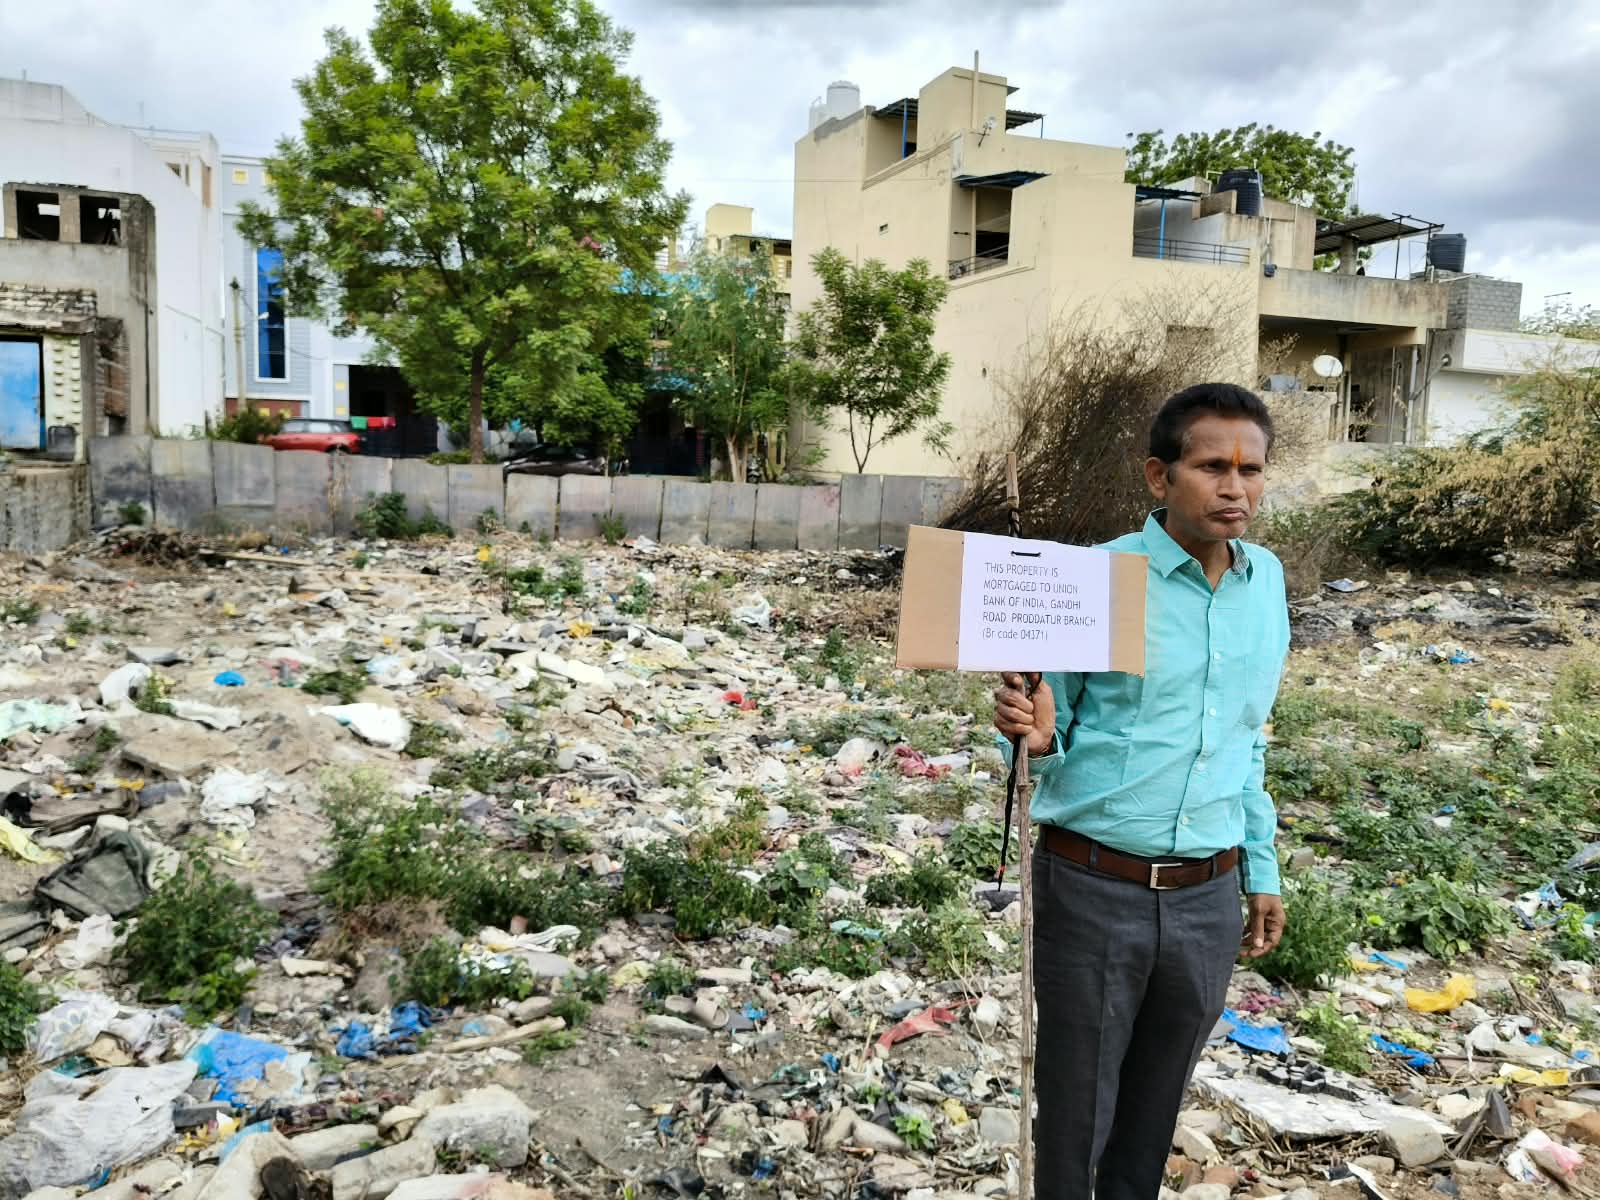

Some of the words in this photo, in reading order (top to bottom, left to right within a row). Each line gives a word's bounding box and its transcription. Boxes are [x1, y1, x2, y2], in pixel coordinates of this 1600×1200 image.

[985, 562, 1004, 574] THIS
[1007, 564, 1048, 577] PROPERTY
[1052, 567, 1058, 577] IS
[984, 580, 1037, 592] MORTGAGED
[1040, 583, 1050, 592] TO
[1054, 584, 1078, 594] UNION
[984, 595, 1005, 606] BANK
[1009, 597, 1019, 607] OF
[1023, 598, 1047, 610] INDIA,
[1051, 599, 1081, 609] GANDHI
[983, 612, 1006, 622] ROAD
[1012, 614, 1062, 625] PRODDATUR
[1064, 616, 1096, 626] BRANCH
[982, 628, 995, 640] (Br
[998, 630, 1018, 639] code
